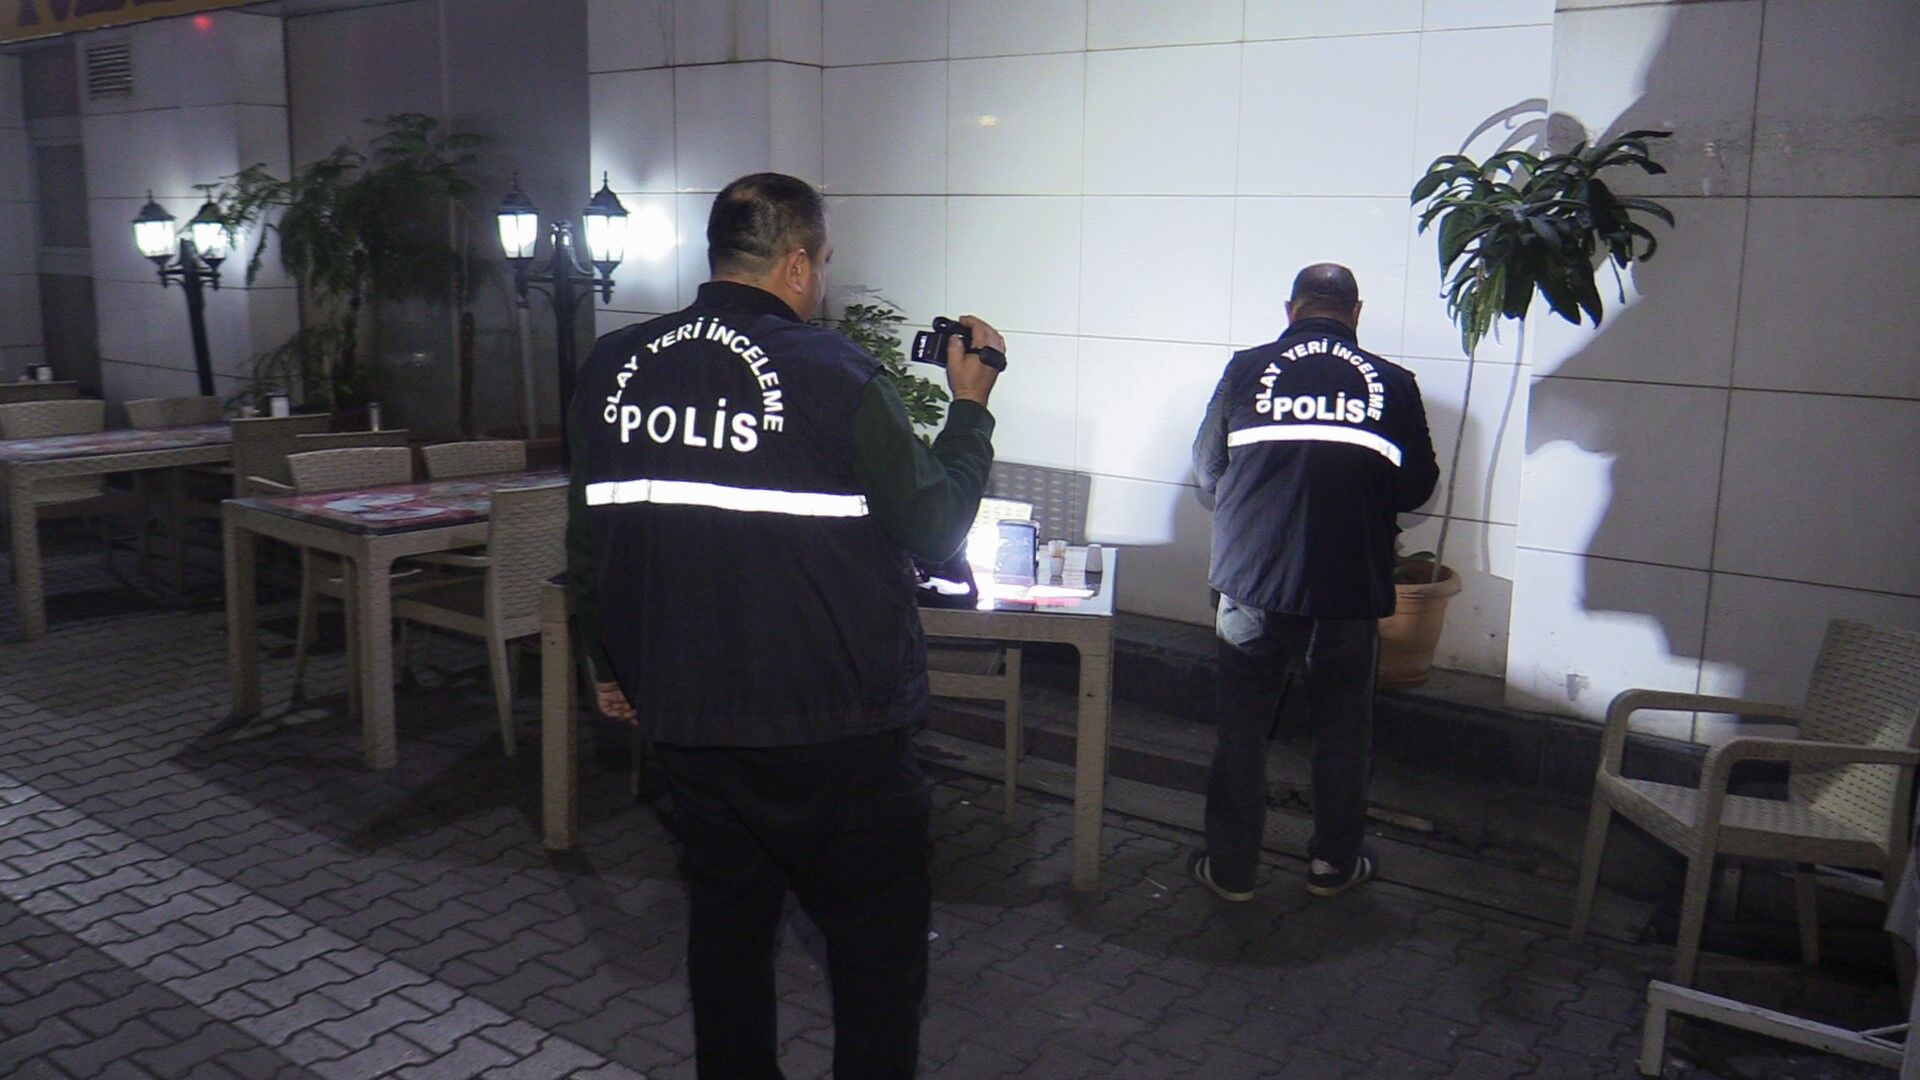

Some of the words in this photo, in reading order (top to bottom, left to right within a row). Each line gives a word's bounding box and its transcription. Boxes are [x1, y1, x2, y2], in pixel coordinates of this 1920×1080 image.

[603, 355, 640, 424] OLAY
[646, 317, 704, 354] YERİ
[706, 317, 784, 433] İNCELEME
[1255, 362, 1283, 414] OLAY
[1281, 338, 1328, 361] YERİ
[1332, 341, 1384, 421] İNCELEME
[1273, 391, 1366, 424] POLİS
[620, 398, 758, 453] POLİS
